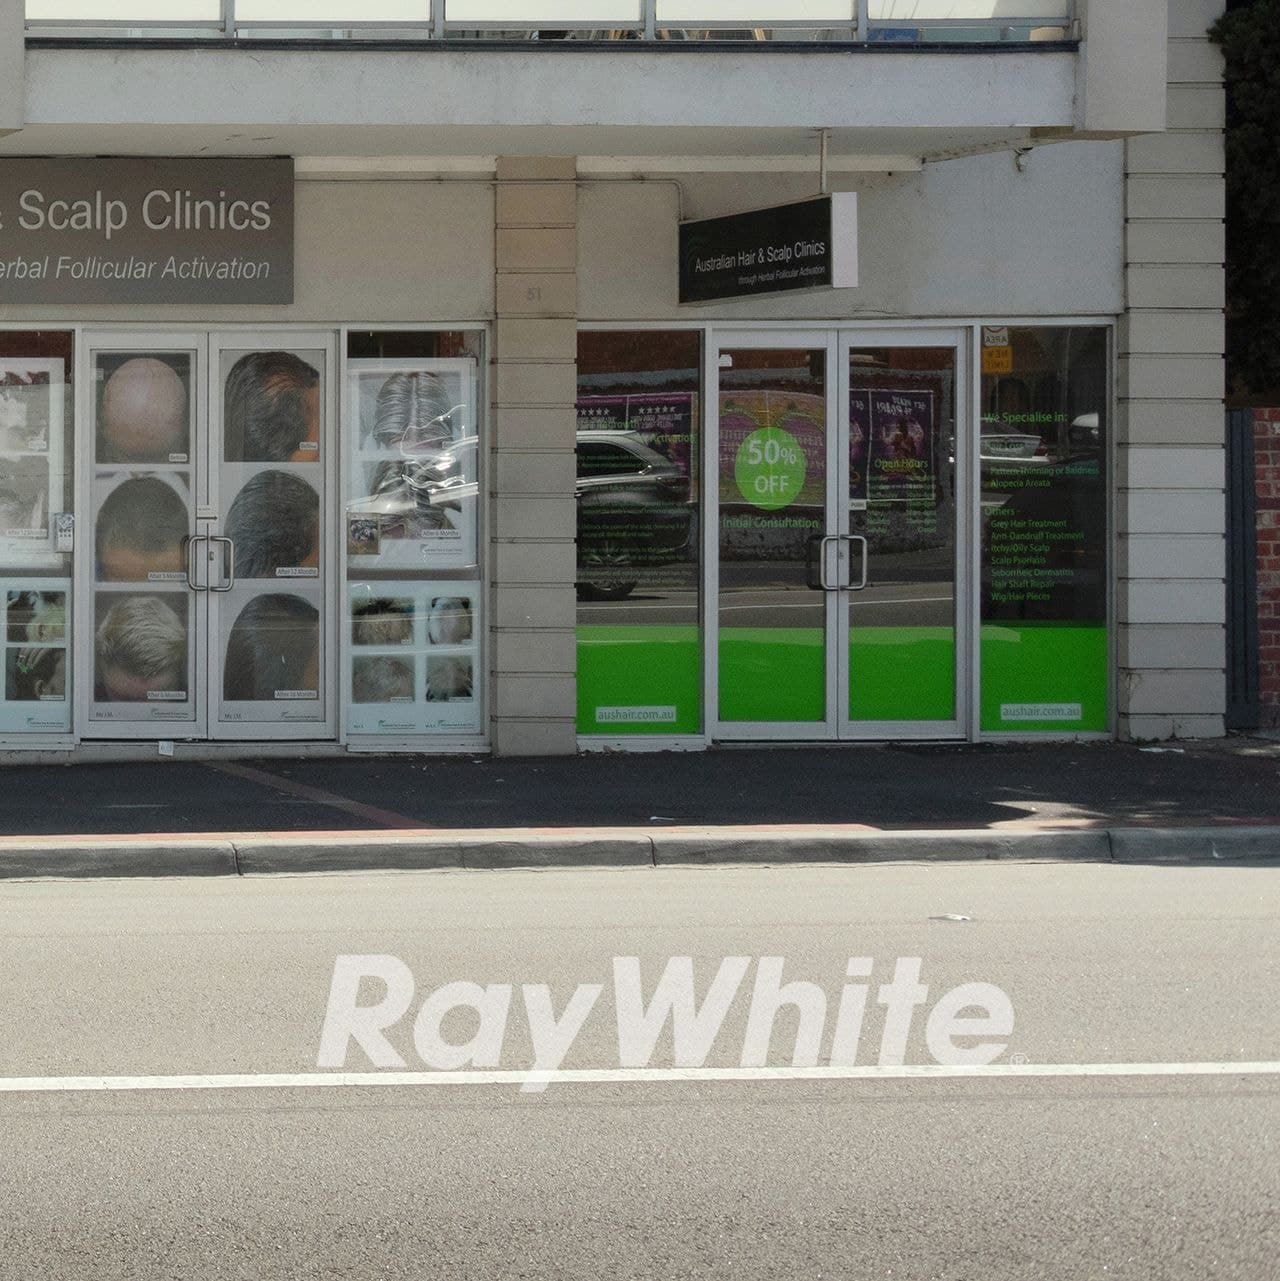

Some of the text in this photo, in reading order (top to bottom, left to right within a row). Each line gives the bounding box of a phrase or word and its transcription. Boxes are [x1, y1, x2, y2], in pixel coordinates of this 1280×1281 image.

[18, 189, 128, 240] Scalp
[142, 189, 272, 231] Clinics
[55, 256, 156, 280] Follicular
[161, 257, 271, 280] Activation
[695, 239, 826, 273] Australian Hair & Scalp Clinics
[985, 412, 999, 424] We
[1001, 412, 1053, 425] Specialise
[748, 438, 798, 466] 50%
[754, 475, 790, 494] OFF
[598, 709, 675, 721] aushair.com.au
